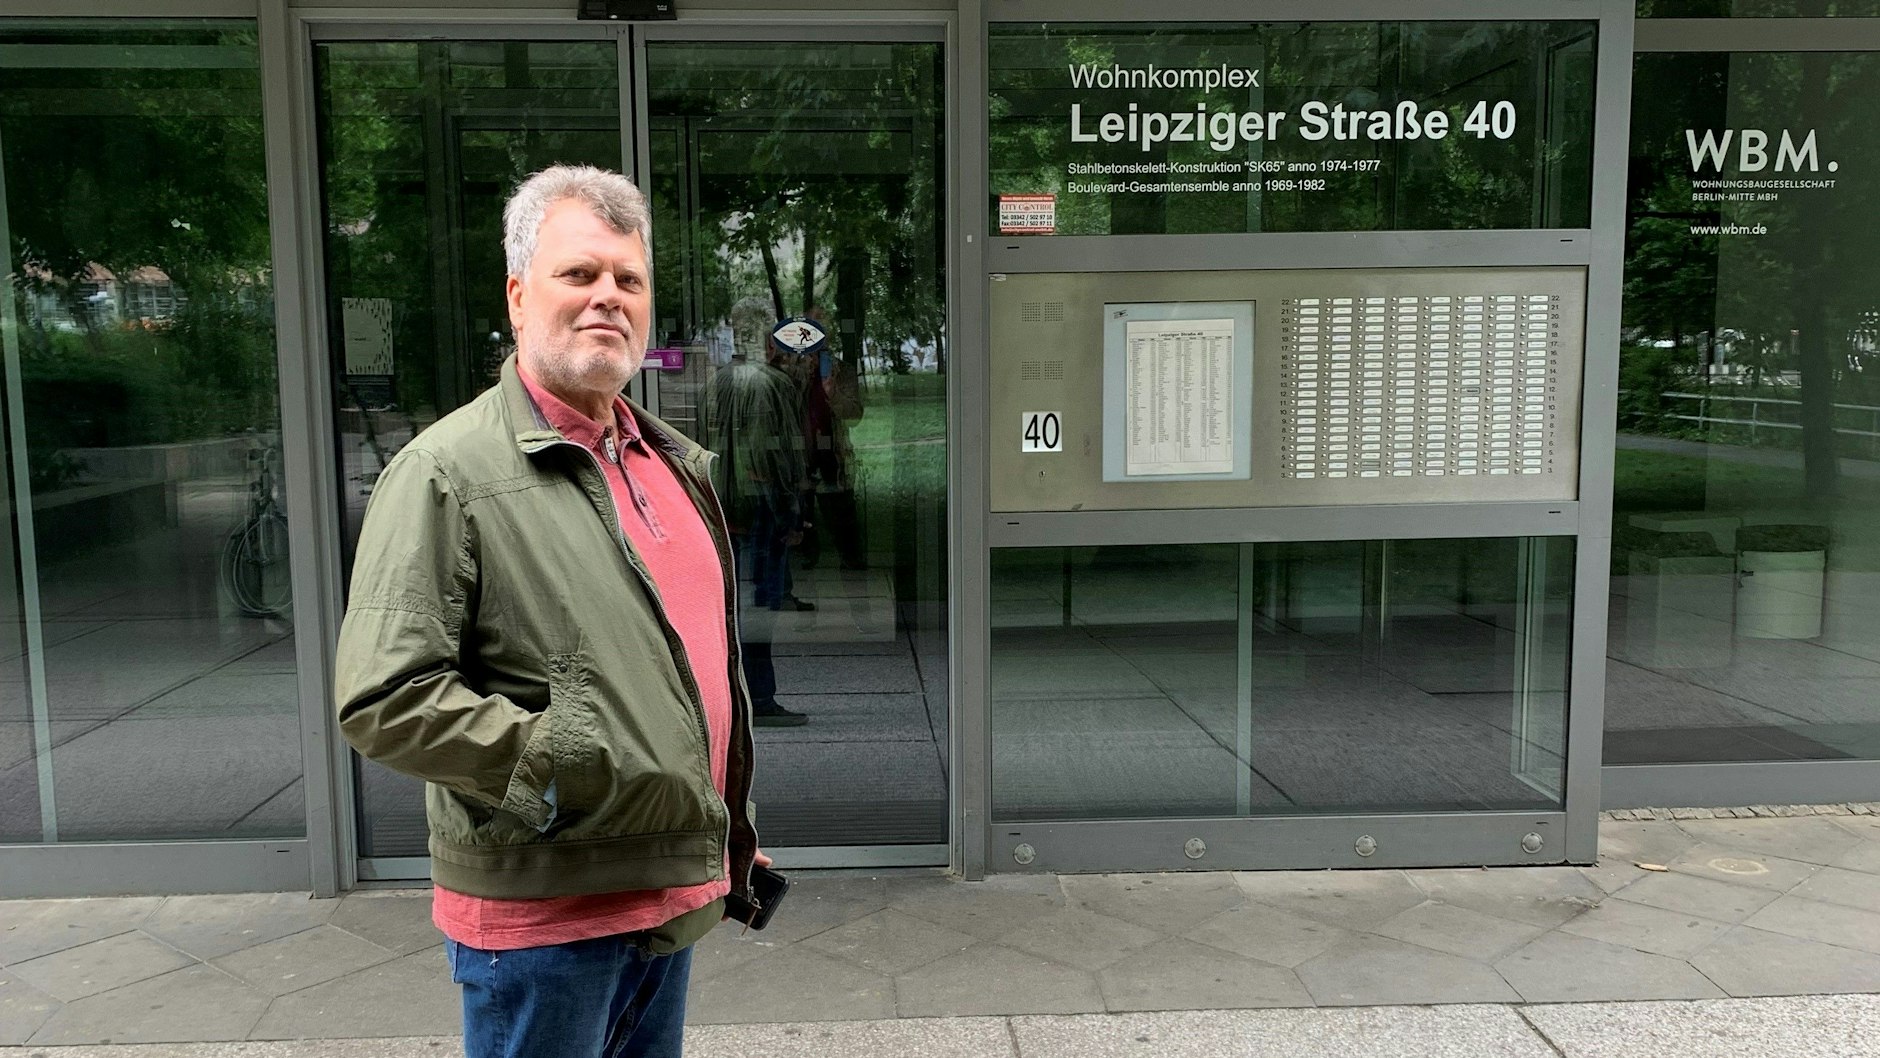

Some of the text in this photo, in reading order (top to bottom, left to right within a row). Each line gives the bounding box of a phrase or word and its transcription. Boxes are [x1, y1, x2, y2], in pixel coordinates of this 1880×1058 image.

[1068, 62, 1260, 94] Wohnkomplex
[1071, 100, 1517, 152] Leipziger Straße 40
[1685, 128, 1839, 173] WBM.
[1067, 160, 1381, 174] Stahlbetonskelett-Konstruktion "SK65" anno 1974-1977
[1067, 179, 1326, 193] Boulevard-Gesamtensemble anno 1969-1982
[1692, 179, 1836, 189] WOHNUNGSBAUGESELLSCHAFT
[1692, 192, 1778, 202] BERLIN-MITTE MBH
[1001, 203, 1017, 211] CITY
[1690, 222, 1768, 235] www.wbm.de
[1025, 413, 1059, 449] 40
